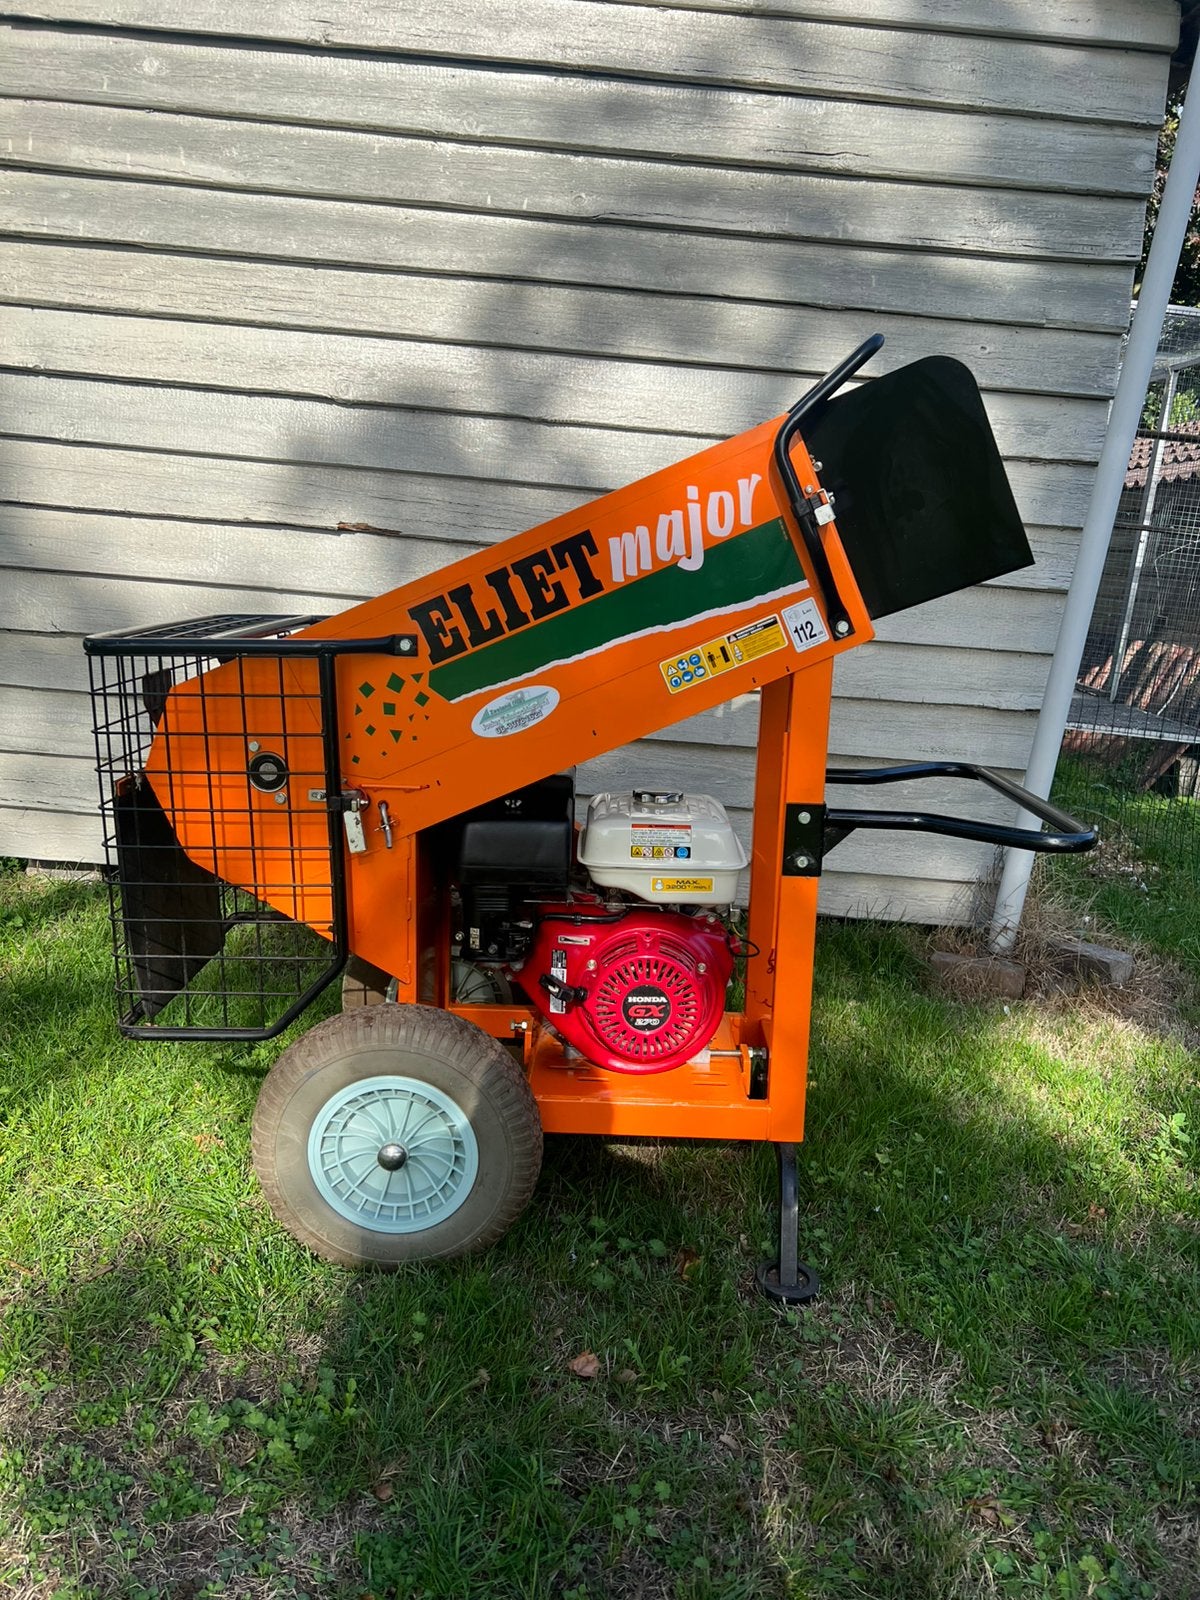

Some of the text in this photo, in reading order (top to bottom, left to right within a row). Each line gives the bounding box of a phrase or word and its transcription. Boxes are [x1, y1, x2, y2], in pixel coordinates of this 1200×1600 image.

[408, 473, 762, 666] ELIET major
[793, 620, 818, 644] 112
[628, 1005, 666, 1017] GX
[634, 1018, 660, 1026] 270
